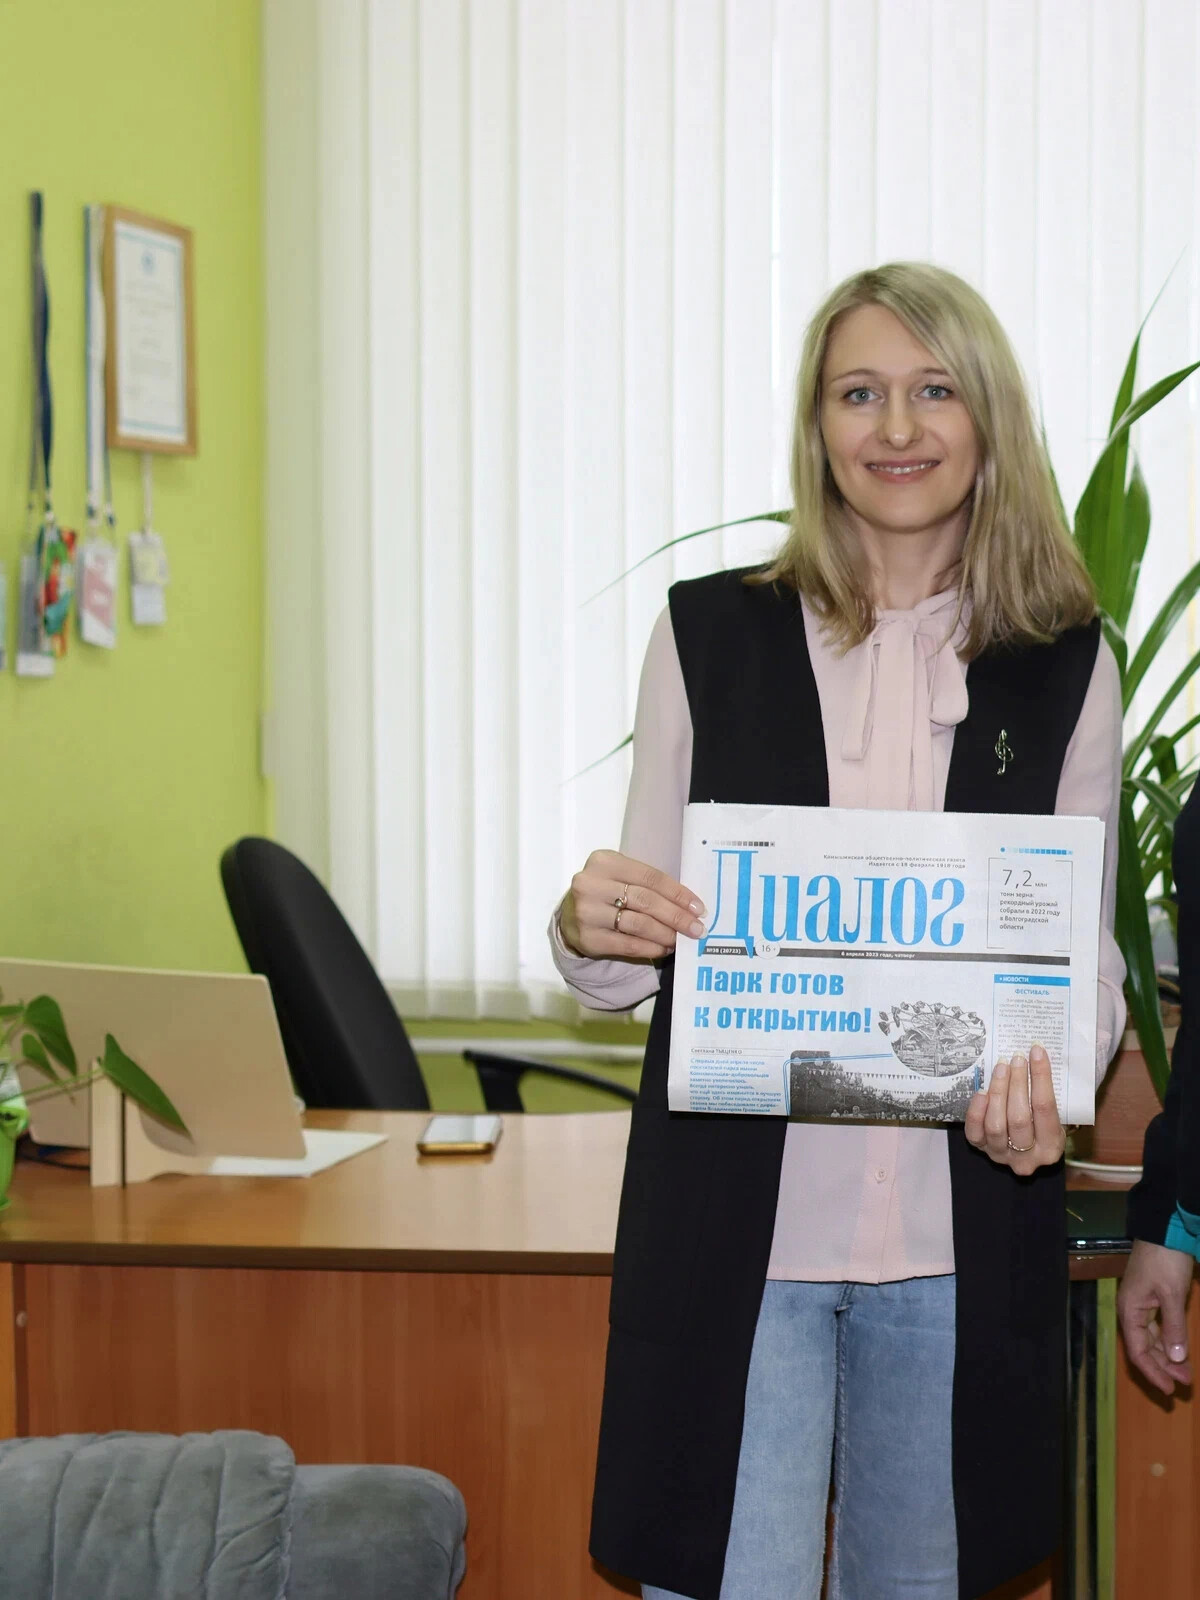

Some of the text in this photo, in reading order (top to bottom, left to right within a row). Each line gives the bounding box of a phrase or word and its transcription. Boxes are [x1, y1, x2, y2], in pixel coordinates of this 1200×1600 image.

[1002, 869, 1032, 889] 7,2
[698, 850, 966, 958] Диалог
[696, 966, 844, 996] Парк готов
[694, 1006, 872, 1033] к открытию!
